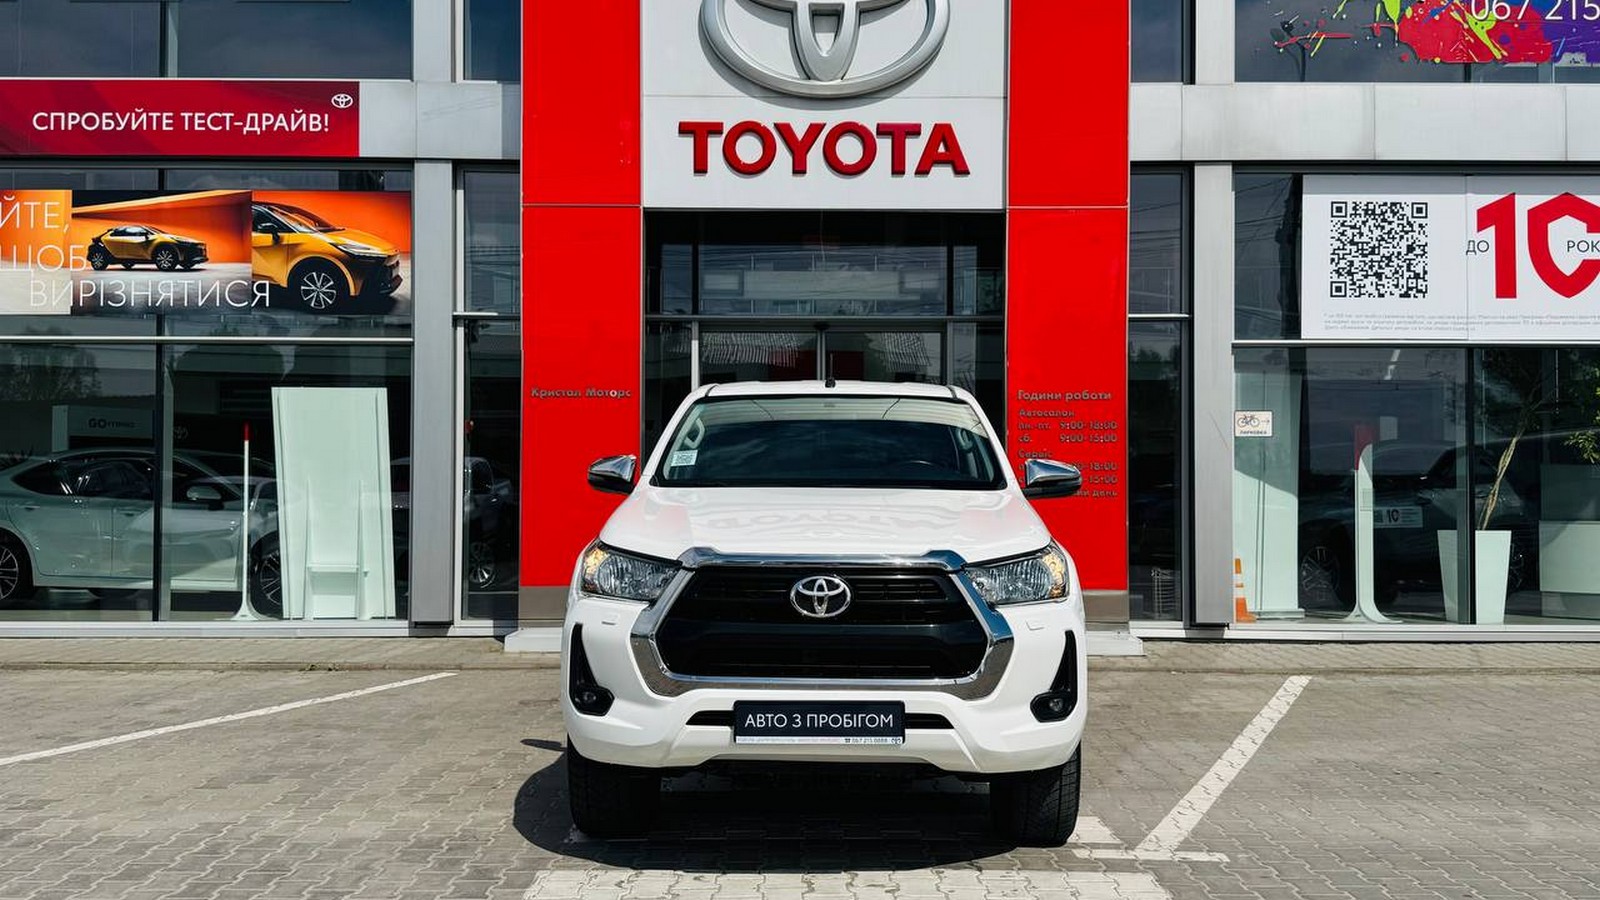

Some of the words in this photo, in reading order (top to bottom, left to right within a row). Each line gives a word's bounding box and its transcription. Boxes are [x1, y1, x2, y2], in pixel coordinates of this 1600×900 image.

[1471, 0, 1530, 20] 067
[1545, 0, 1600, 20] 215
[32, 108, 174, 131] СПРОБУЙТЕ
[181, 108, 329, 135] ТЕСТ-ДРАЙВ!
[678, 121, 970, 176] TOYOTA
[0, 195, 70, 232] ЙТЕ,
[1466, 240, 1490, 255] ДО
[1477, 192, 1600, 299] 10
[29, 279, 270, 307] ВИРІЗНЯТИСЯ
[531, 387, 581, 398] Кристал
[585, 387, 631, 398] Моторс
[1018, 389, 1062, 401] Години
[1065, 389, 1112, 403] роботи
[744, 713, 788, 728] АВТО
[806, 713, 894, 729] ПРОБІГОМ
